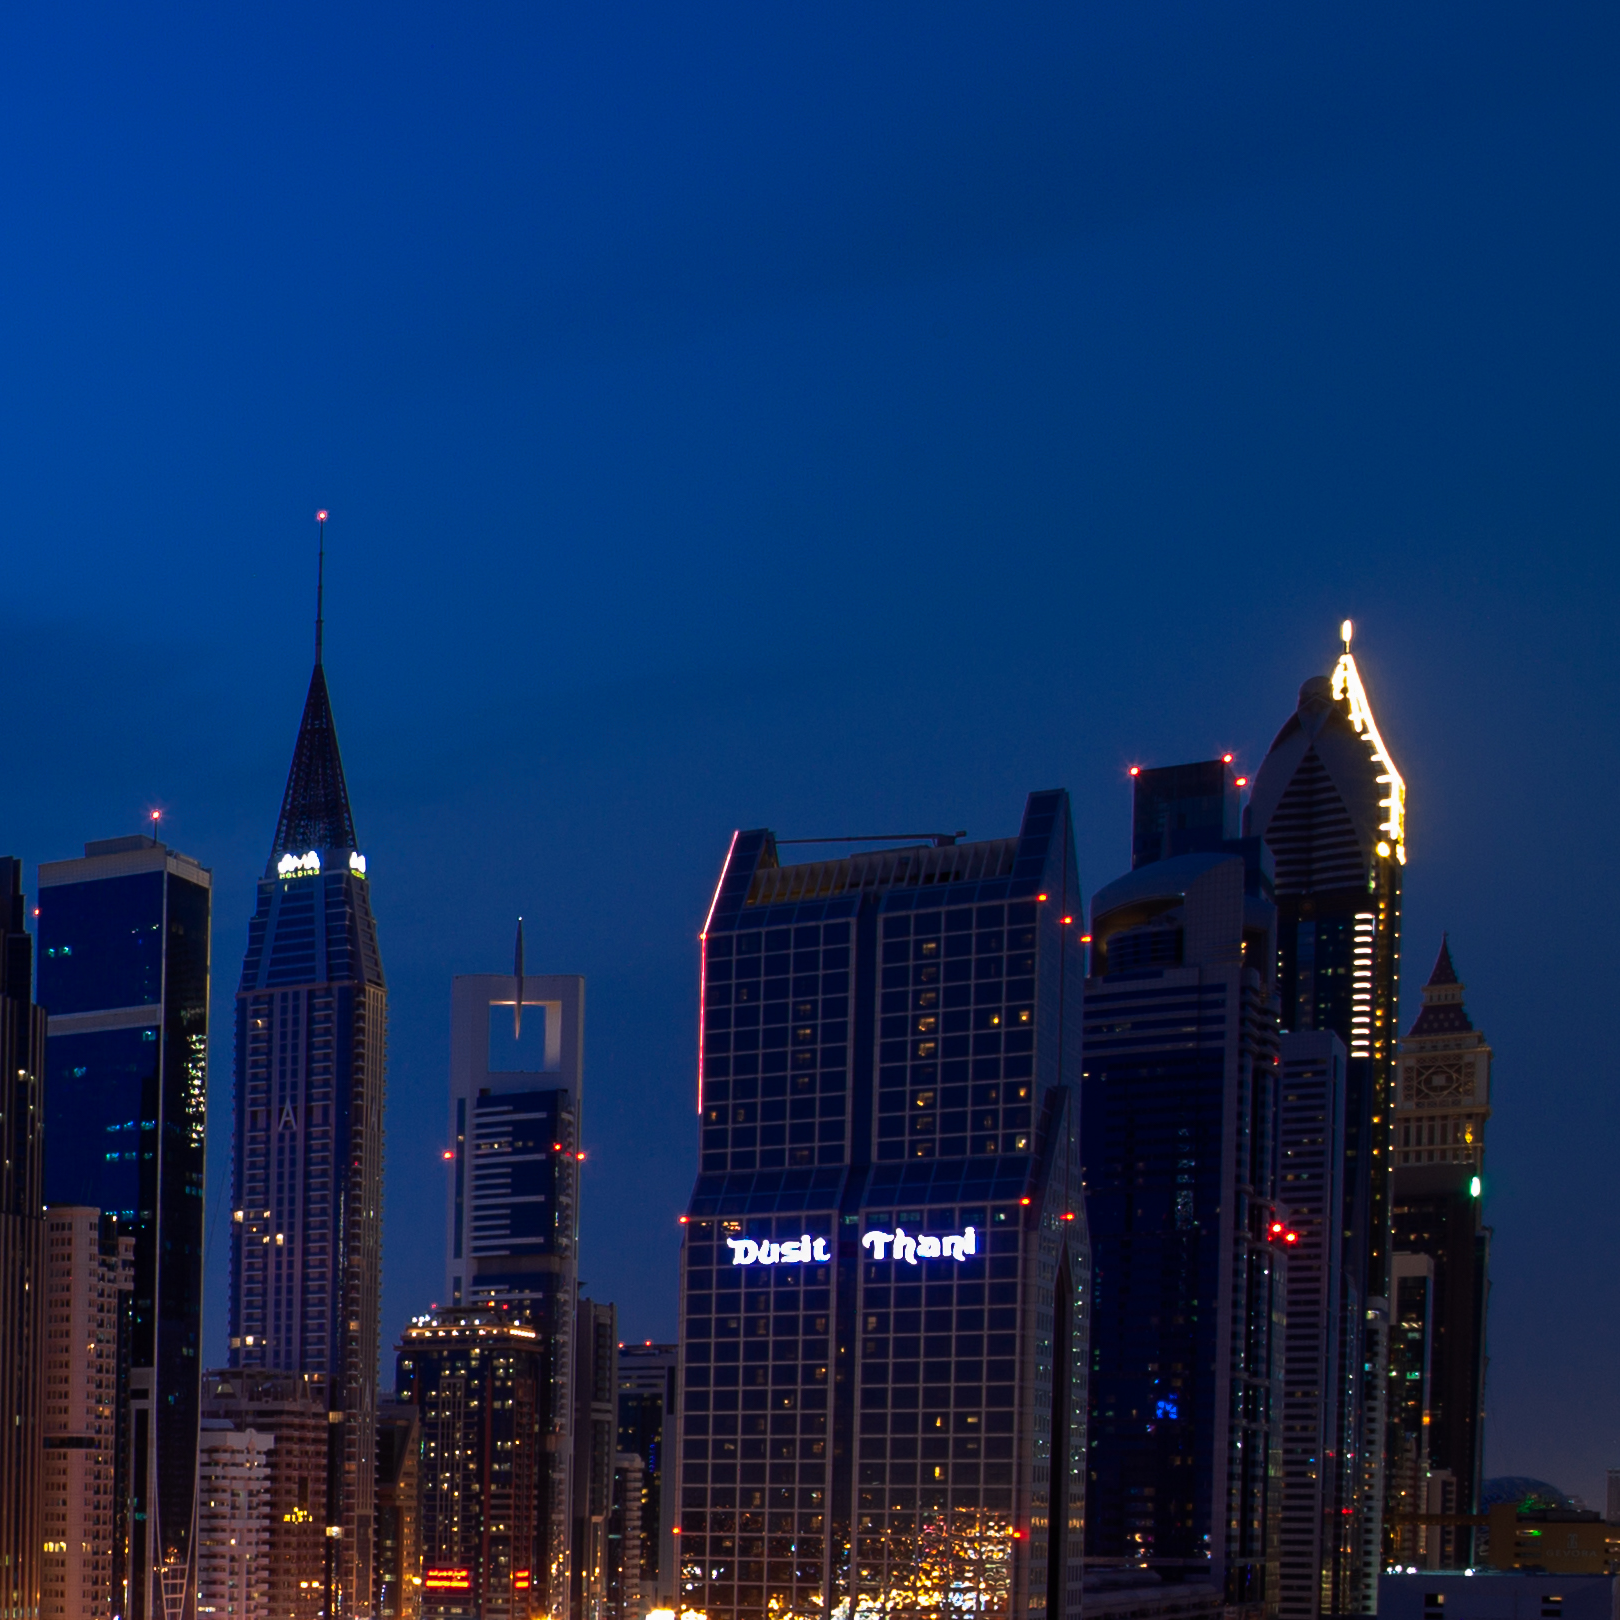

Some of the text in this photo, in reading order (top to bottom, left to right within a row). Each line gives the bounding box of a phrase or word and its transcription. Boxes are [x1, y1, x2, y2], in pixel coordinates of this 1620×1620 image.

[279, 869, 320, 880] HOLDING
[726, 1226, 977, 1266] Dusit Thani
